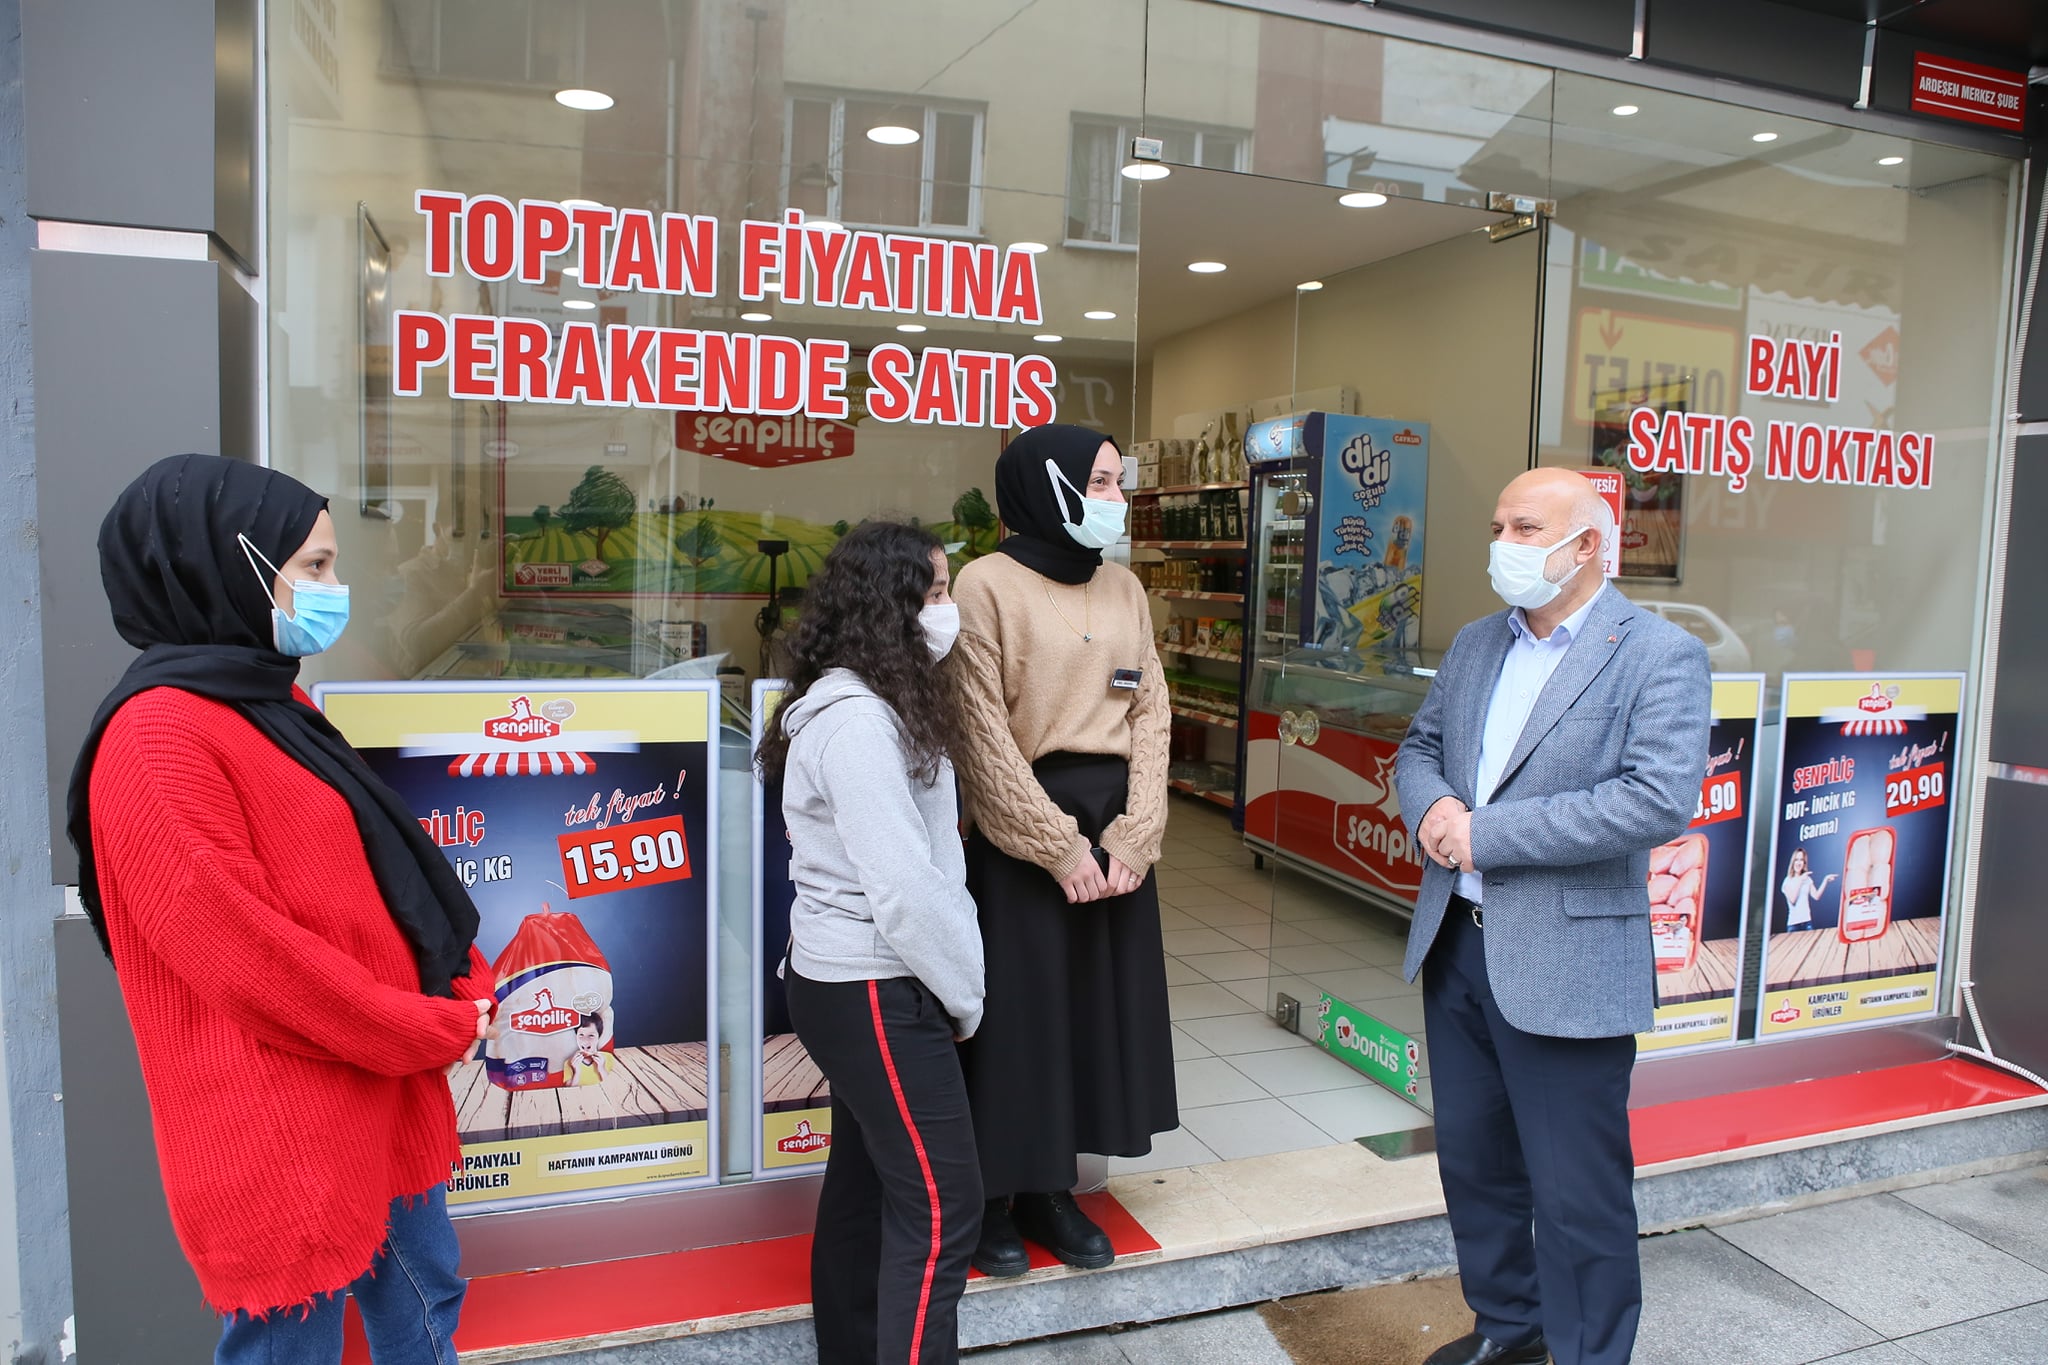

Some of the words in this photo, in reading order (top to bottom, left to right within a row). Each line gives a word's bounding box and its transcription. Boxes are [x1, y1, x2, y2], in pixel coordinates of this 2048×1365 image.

[1919, 76, 1960, 97] ARDEŞEN
[1961, 85, 1996, 105] MERKEZ
[1997, 92, 2020, 110] ŞUBE
[415, 189, 718, 298] TOPTAN
[739, 208, 1043, 324] FİYATINA
[393, 309, 849, 419] PERAKENDE
[1747, 331, 1842, 402] BAYİ
[693, 413, 835, 457] şenpiliç
[1627, 407, 1755, 493] SATIŞ
[1765, 419, 1935, 490] NOKTASI
[491, 718, 552, 737] şenpiliç
[1793, 755, 1855, 793] ŞENPİLİÇ
[1886, 771, 1944, 809] 20,90
[565, 791, 602, 827] tek
[595, 782, 666, 830] fiyat
[1785, 800, 1809, 821] BUT-
[1811, 792, 1840, 815] İNCİK
[1841, 790, 1857, 807] KG
[1799, 817, 1839, 842] (sarma)
[484, 855, 512, 883] KG
[565, 830, 686, 886] 15,90
[1808, 991, 1849, 1006] KAMPANYALI
[1812, 1005, 1842, 1019] ÜRÜNLER
[517, 1010, 573, 1029] şenpiliç
[1351, 1023, 1399, 1073] bonus
[548, 1157, 596, 1172] HAFTANIN
[598, 1150, 658, 1166] KAMPANYALI
[660, 1145, 694, 1159] ÜRÜNÜ
[783, 1133, 826, 1151] şenpiliç
